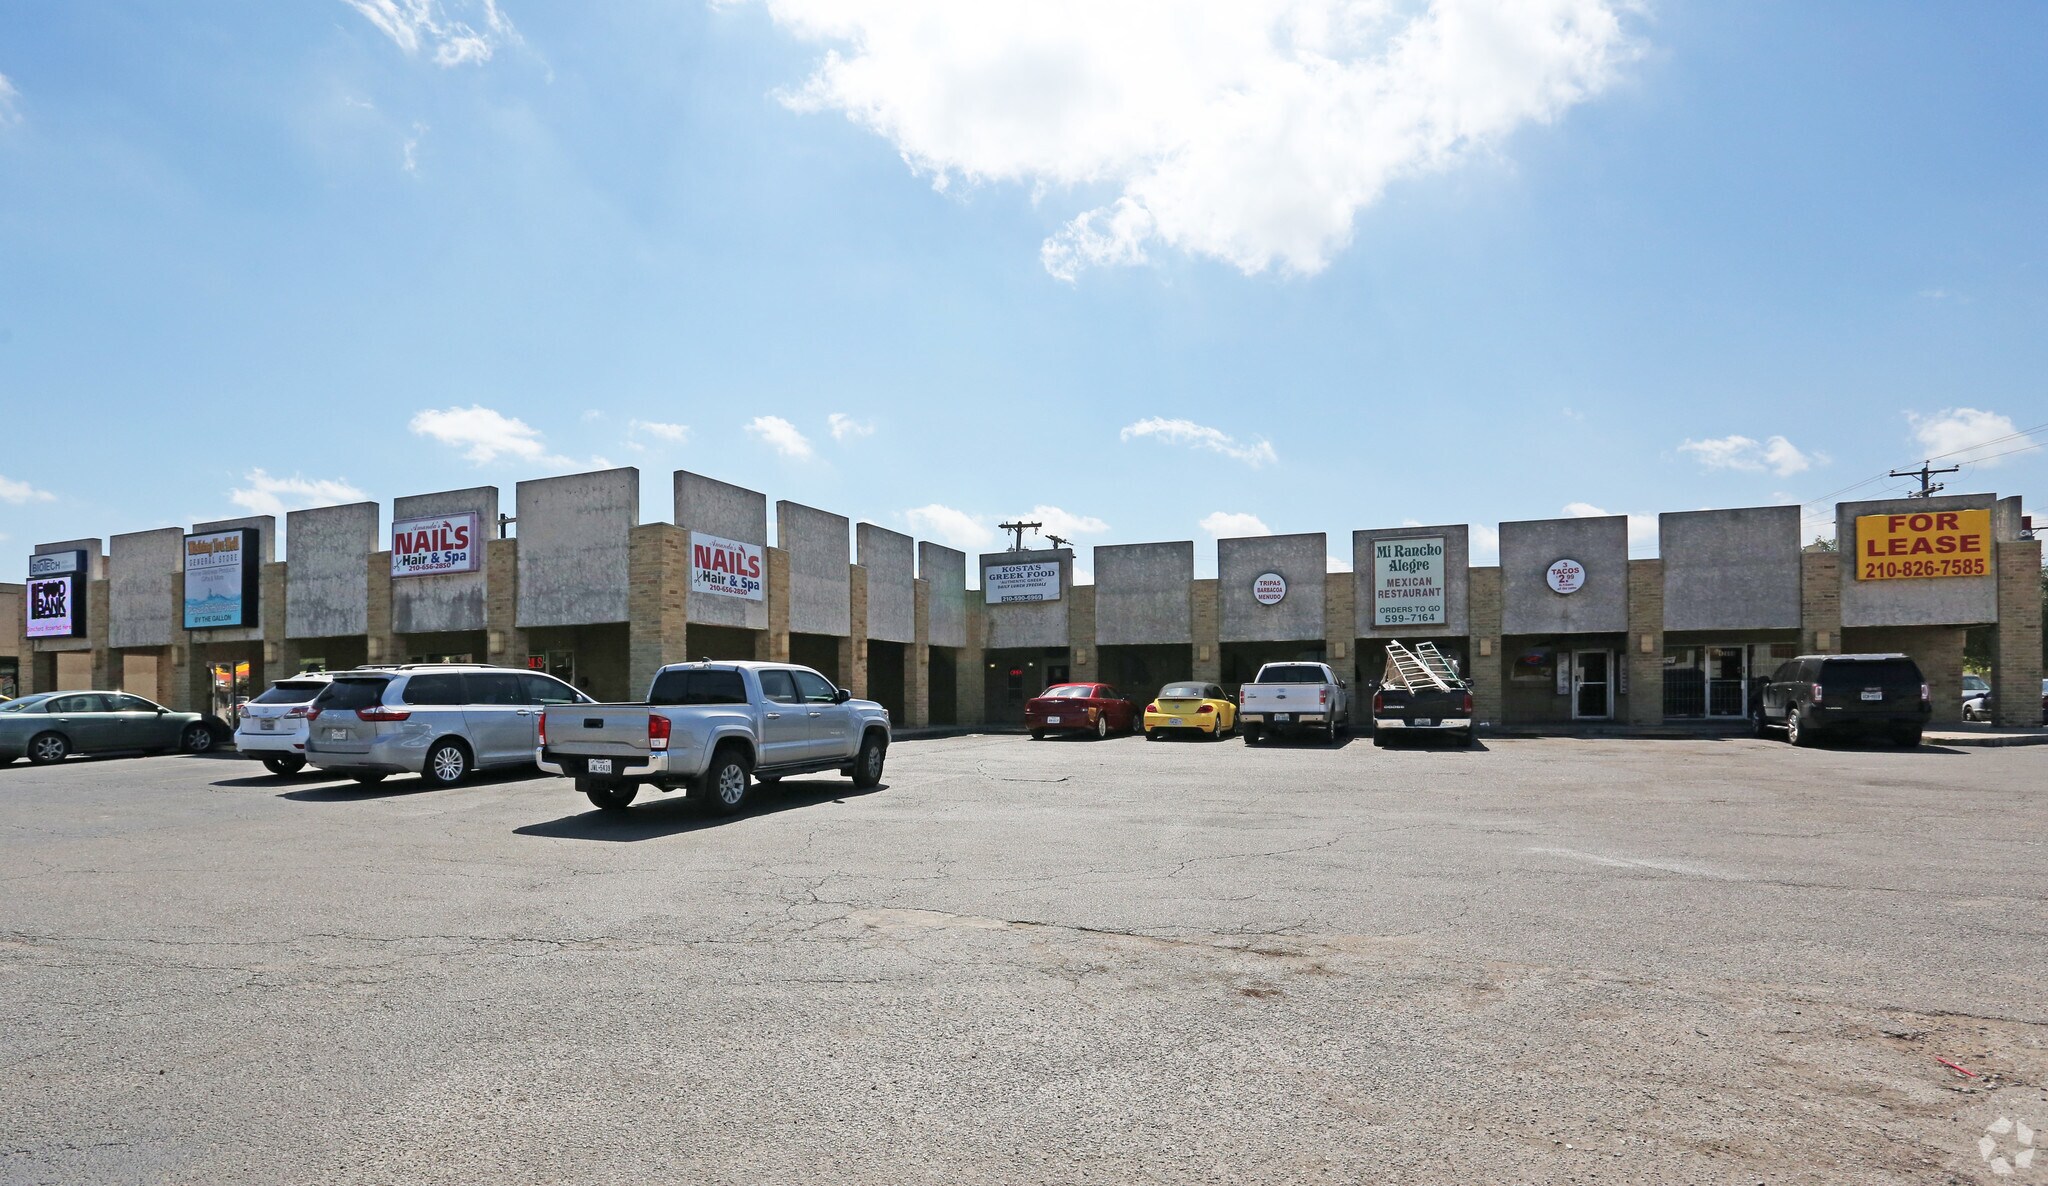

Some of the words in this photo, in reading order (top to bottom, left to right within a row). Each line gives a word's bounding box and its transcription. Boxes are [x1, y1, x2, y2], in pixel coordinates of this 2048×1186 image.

[1888, 513, 1959, 533] FOR
[395, 526, 469, 555] NAILS
[1867, 534, 1981, 556] LEASE
[1376, 545, 1391, 558] Mi
[1394, 544, 1442, 557] Rancho
[189, 557, 216, 567] GENERAL
[219, 554, 238, 564] STORE
[402, 553, 428, 566] Hair
[431, 552, 440, 563] &
[444, 551, 466, 564] Spa
[694, 544, 760, 578] NAILS
[408, 562, 452, 572] 210-656-2850
[1002, 565, 1041, 573] KOSTA'S
[1389, 559, 1430, 574] Alegre
[1551, 567, 1580, 575] TACOS
[1865, 558, 1984, 578] 210-826-7585
[702, 570, 726, 585] Hair
[730, 575, 738, 587] &
[741, 577, 760, 592] Spa
[1387, 577, 1432, 587] MEXICAN
[709, 584, 748, 595] 210-656-2850
[1378, 588, 1441, 598] RESTAURANT
[38, 597, 66, 618] BANK
[211, 614, 231, 622] GALLON
[1385, 613, 1435, 622] 599-7164
